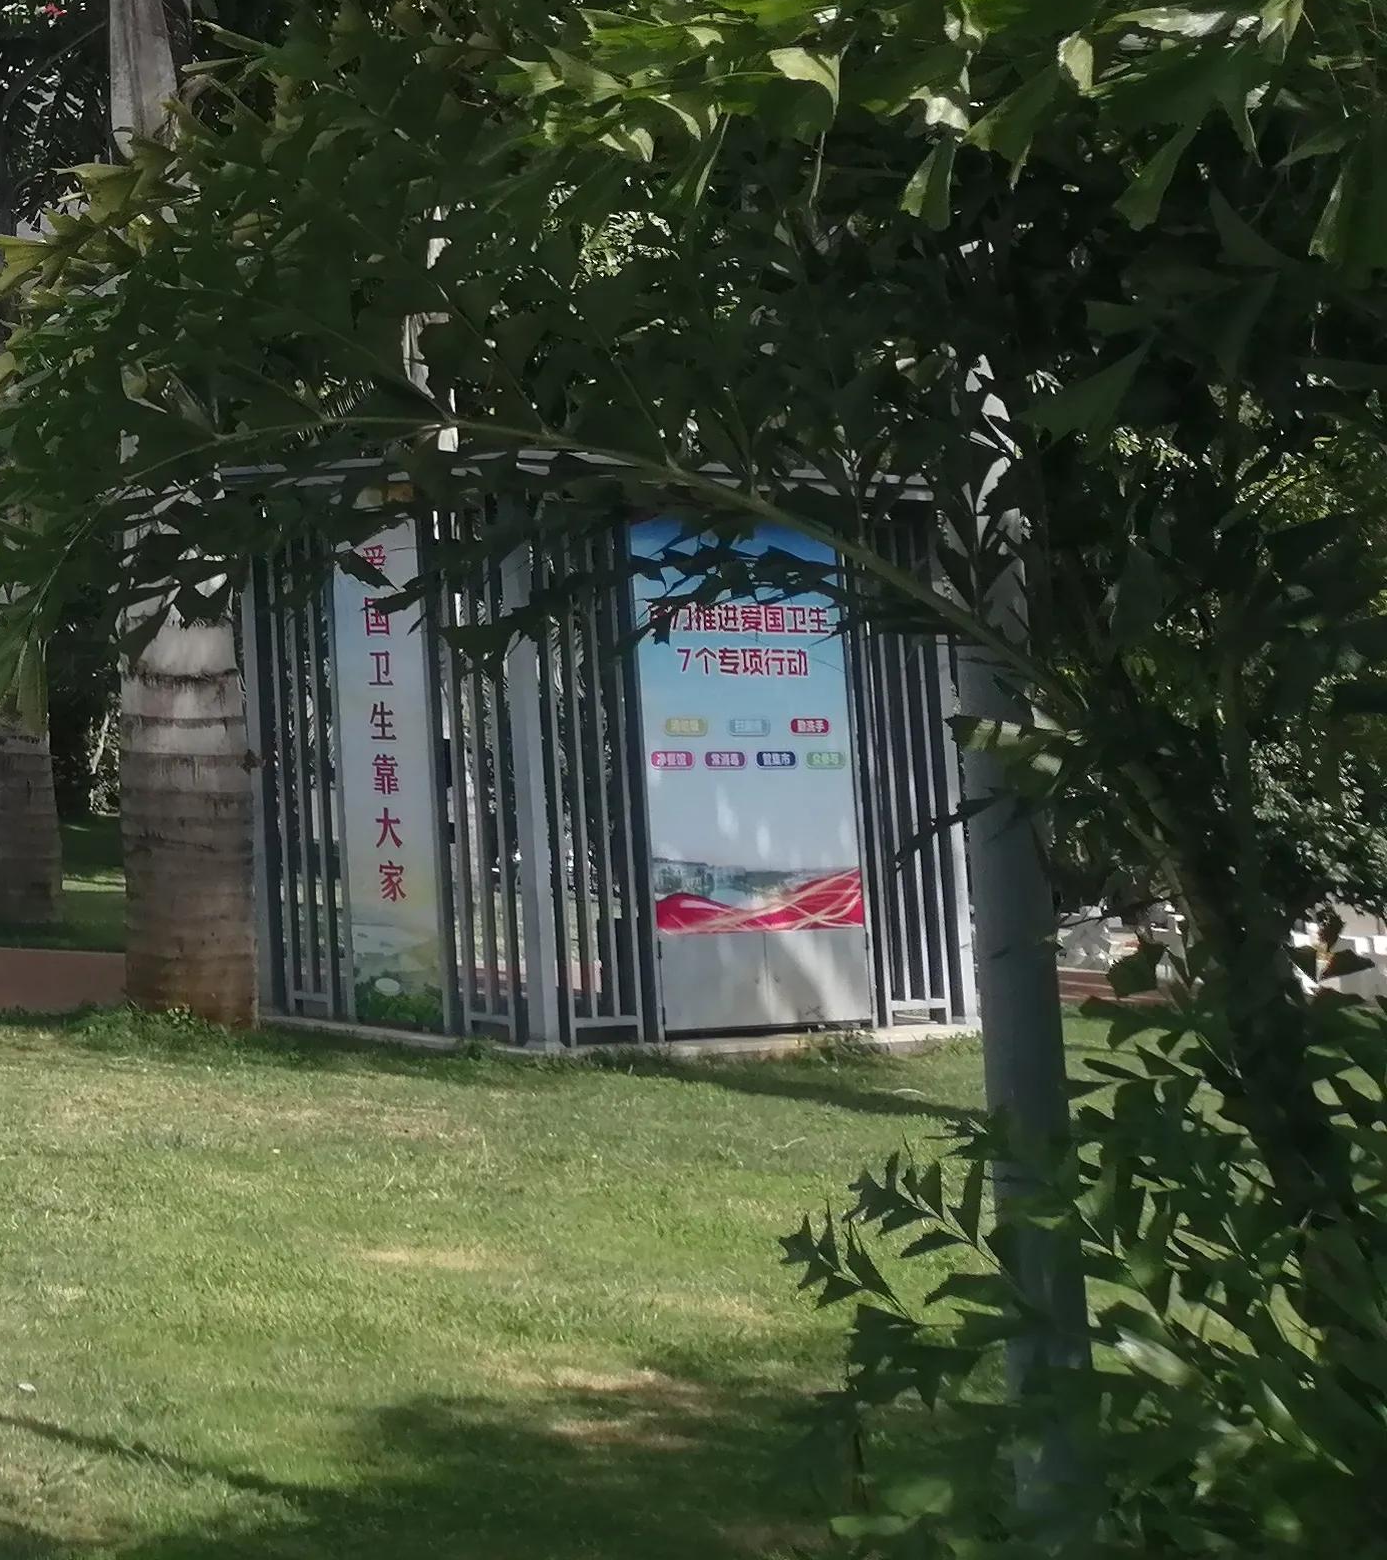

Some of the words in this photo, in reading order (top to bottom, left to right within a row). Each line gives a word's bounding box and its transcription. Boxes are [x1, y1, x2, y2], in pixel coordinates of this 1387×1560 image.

[677, 647, 809, 676] 7个专项行动
